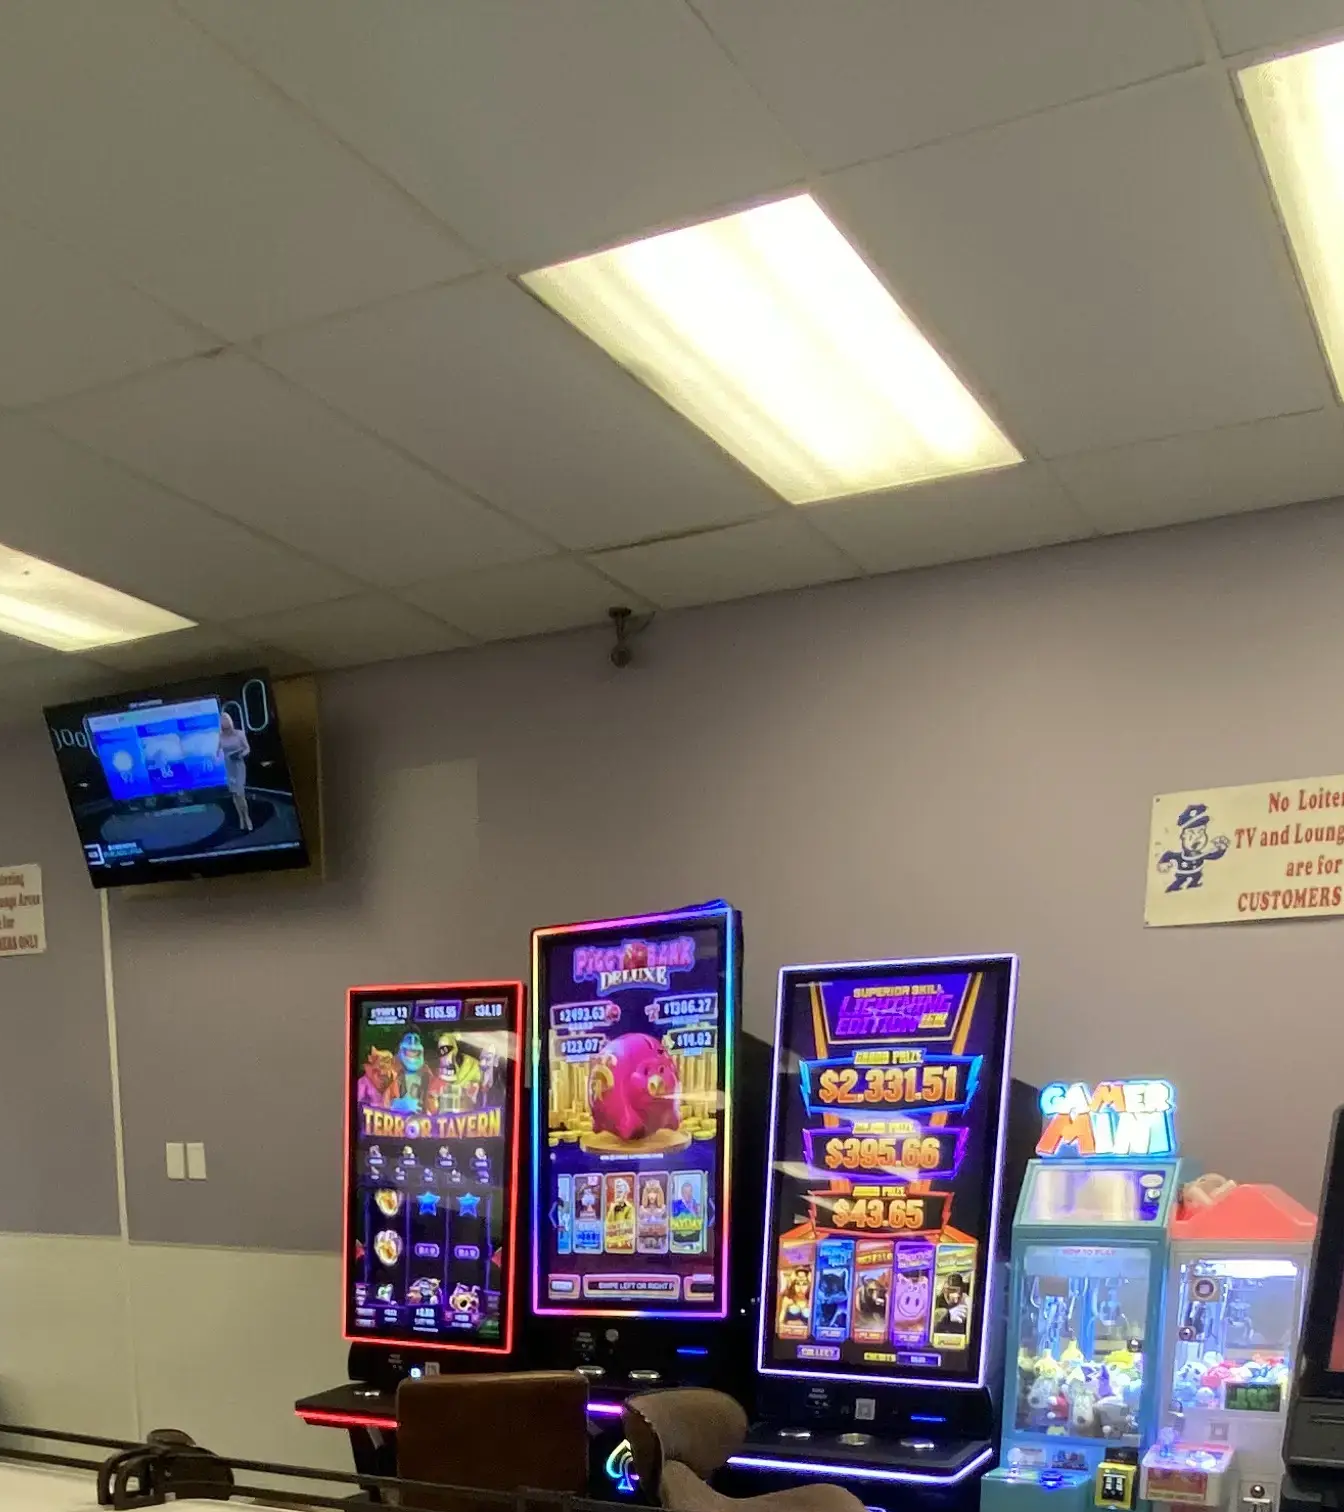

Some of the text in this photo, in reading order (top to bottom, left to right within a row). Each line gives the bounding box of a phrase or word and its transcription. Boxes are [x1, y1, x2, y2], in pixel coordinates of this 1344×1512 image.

[1268, 791, 1290, 814] No
[1234, 827, 1256, 849] TV
[1260, 825, 1290, 846] and
[1286, 854, 1343, 877] are for
[1237, 885, 1341, 912] CUSTOMERS
[647, 938, 694, 968] BANK
[600, 966, 668, 991] DELUXE
[853, 985, 910, 999] SUPERIOR
[839, 994, 954, 1016] LIGHTNING
[835, 1014, 921, 1036] EDITION
[1038, 1079, 1175, 1116] GAMER
[363, 1107, 502, 1139] TERROR TAVERN
[1035, 1111, 1175, 1156] MINI
[824, 1136, 941, 1169] $395.66
[832, 1198, 924, 1229] $43.65
[619, 1281, 636, 1290] LEFT
[636, 1281, 647, 1290] OR
[647, 1281, 669, 1290] RIGHT
